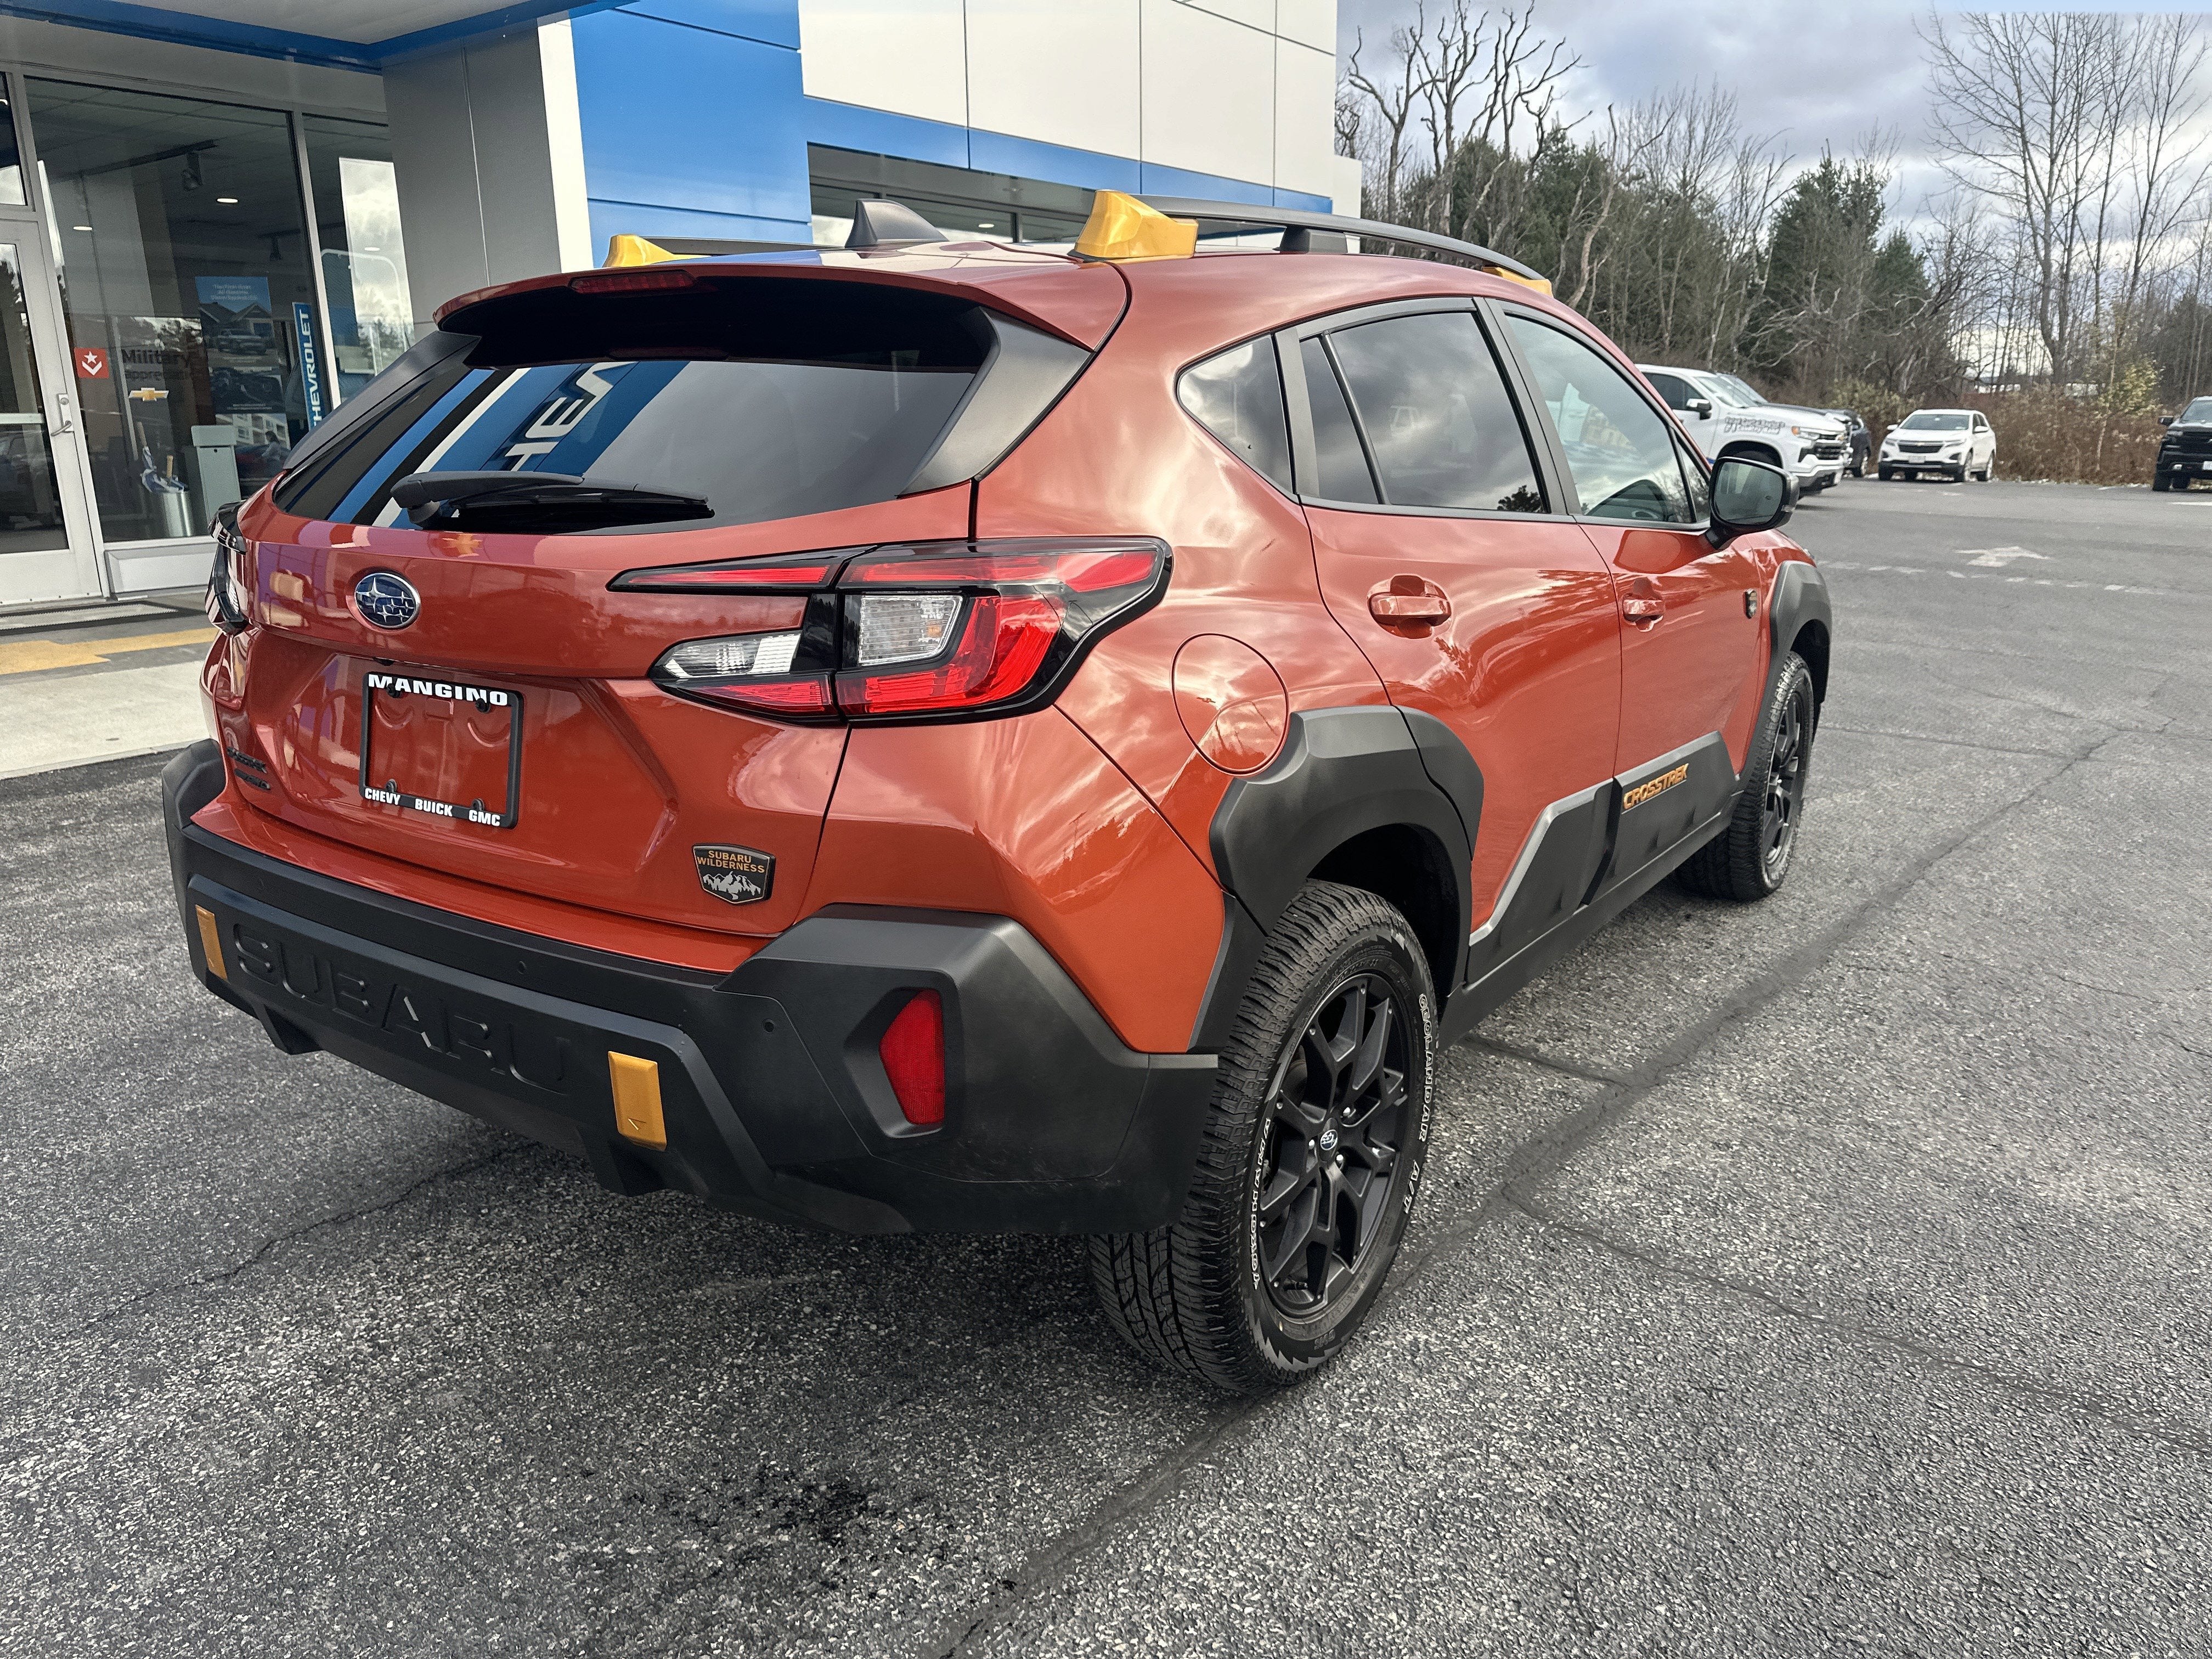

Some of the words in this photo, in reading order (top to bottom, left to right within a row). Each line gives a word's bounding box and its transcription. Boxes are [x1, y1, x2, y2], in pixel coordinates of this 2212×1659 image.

[300, 308, 323, 427] HEVROLET
[368, 674, 508, 707] MANGINO
[364, 788, 401, 806] CHEVY
[414, 798, 453, 817] BUICK
[469, 810, 501, 827] GMC
[1623, 763, 1689, 810] CROSSTREK
[697, 856, 765, 873] WILDERNESS
[708, 850, 752, 864] SUBARU
[233, 922, 573, 1096] SUBARU
[1418, 993, 1434, 1142] GEOLANDAR
[1250, 1118, 1271, 1290] YOKOHAMA
[1403, 1160, 1420, 1214] A/T
